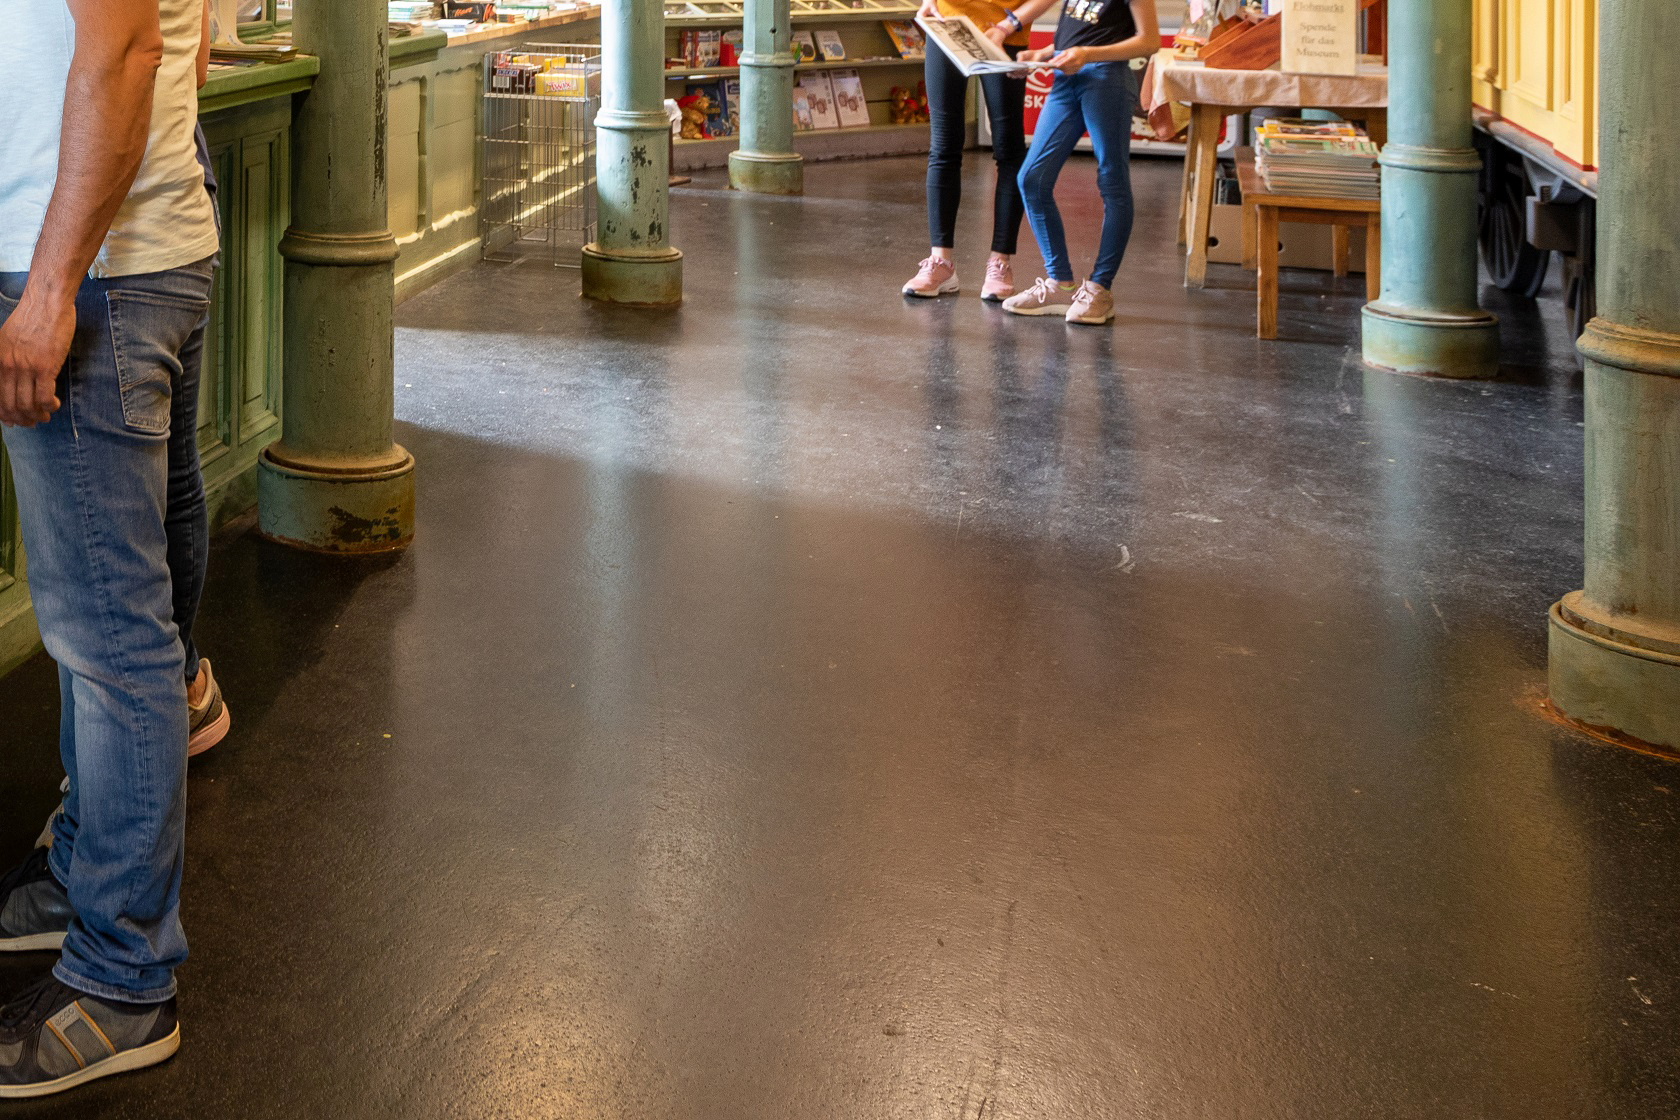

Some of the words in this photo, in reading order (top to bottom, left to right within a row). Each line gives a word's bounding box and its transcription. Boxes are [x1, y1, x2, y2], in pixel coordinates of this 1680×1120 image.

[1293, 1, 1345, 13] Flohmarkt
[1300, 22, 1337, 32] Spende
[1301, 36, 1315, 44] für
[1318, 36, 1336, 45] das
[1296, 47, 1340, 58] Museum
[54, 1007, 75, 1027] ecco
